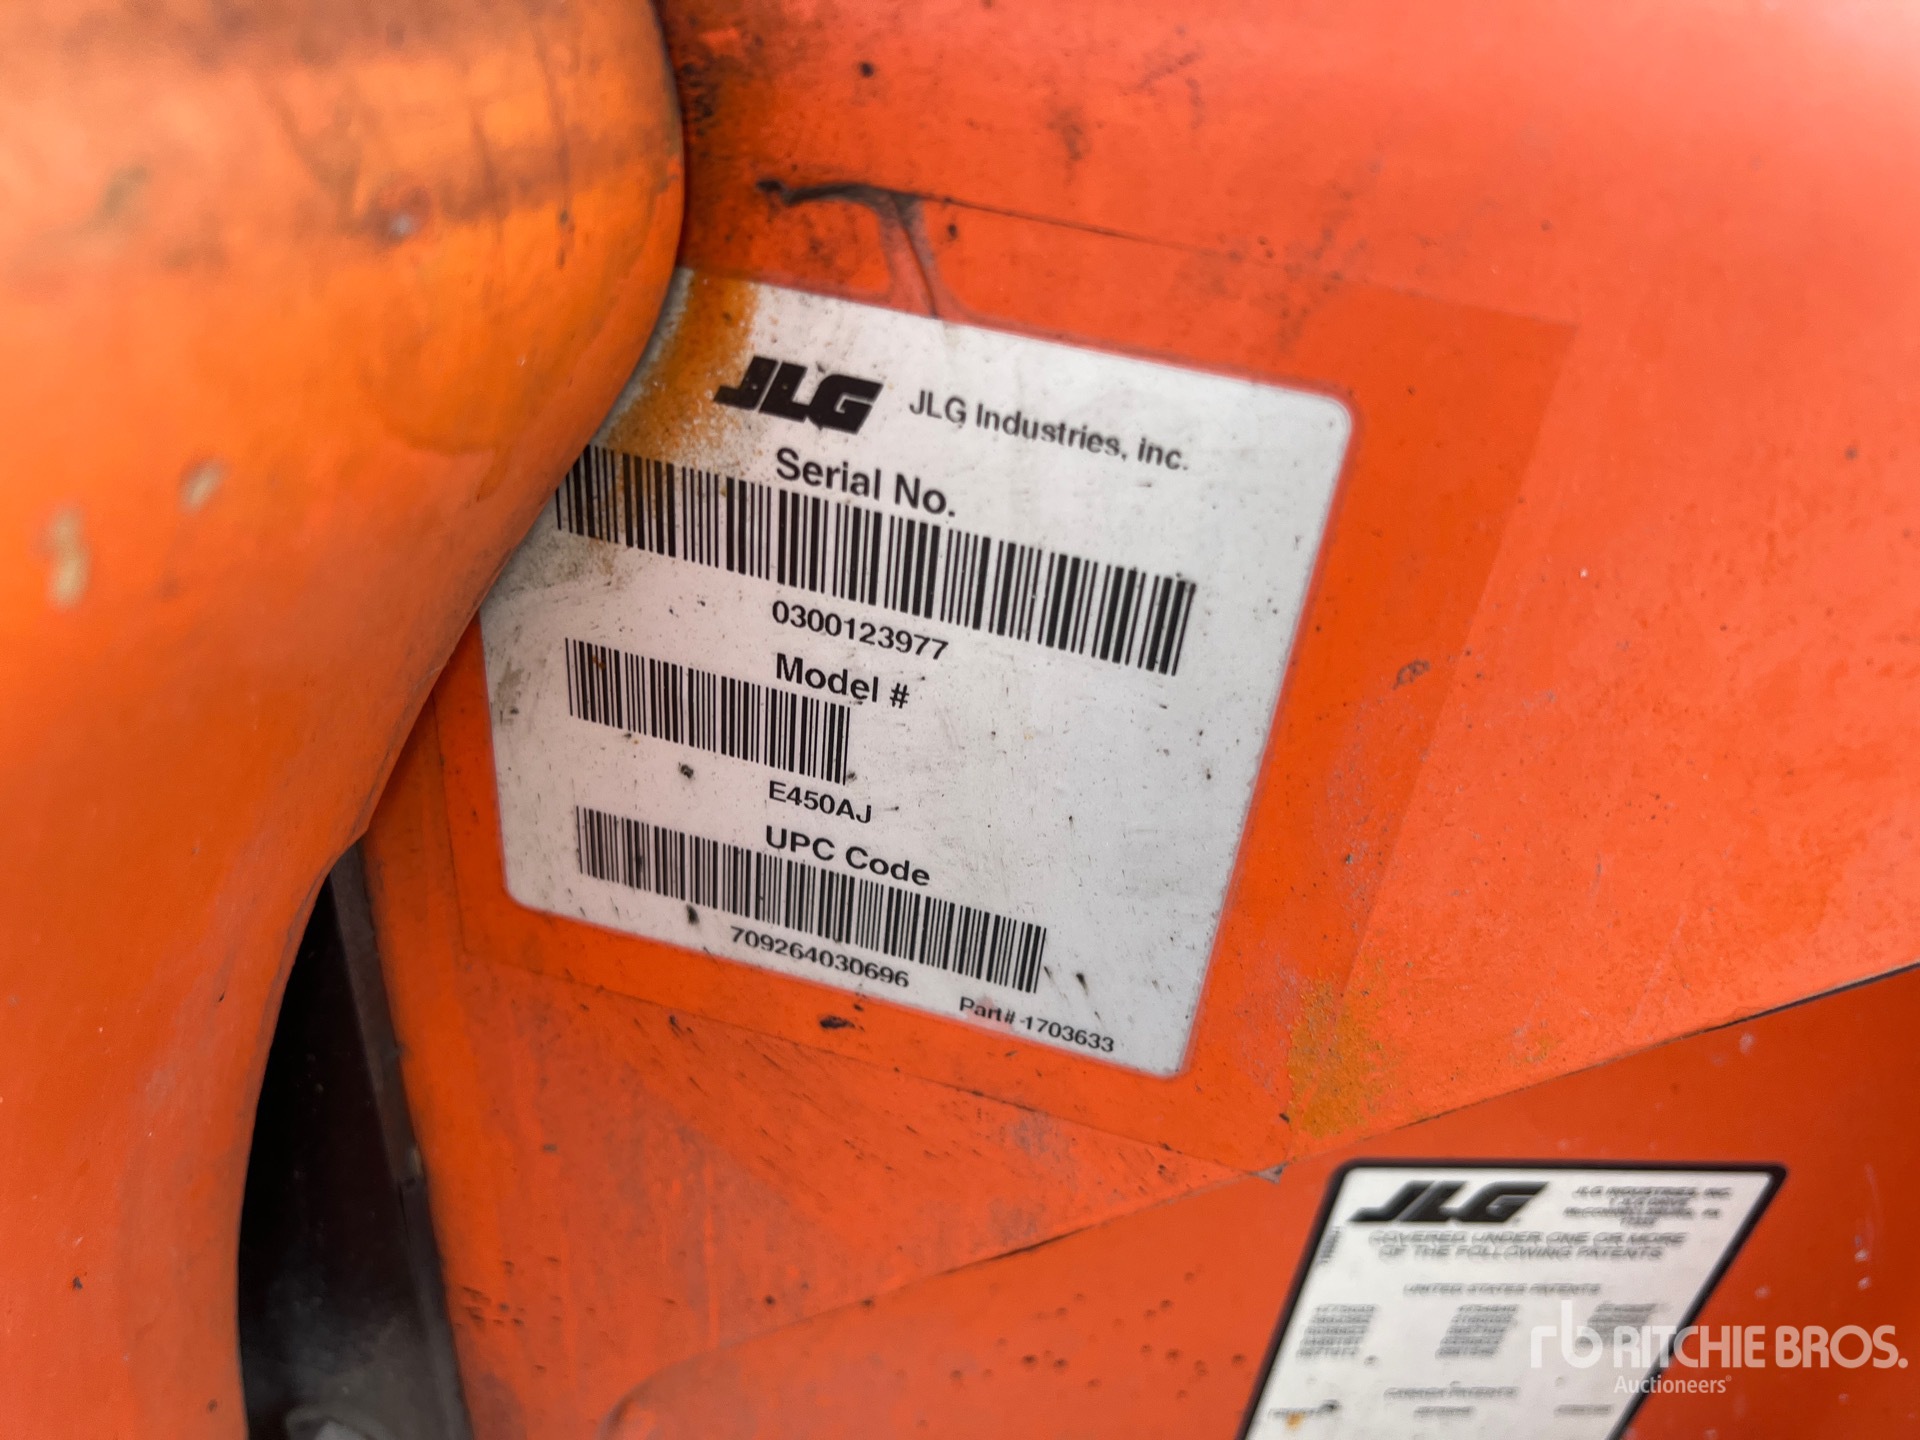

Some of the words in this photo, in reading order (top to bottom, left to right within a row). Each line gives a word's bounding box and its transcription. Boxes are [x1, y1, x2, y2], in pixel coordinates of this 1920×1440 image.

[713, 355, 883, 434] JLG
[910, 391, 967, 424] JLG
[976, 404, 1128, 461] Industries,
[1137, 437, 1189, 471] inc.
[776, 447, 881, 501] Serial
[894, 472, 956, 517] No.
[772, 600, 949, 660] 0300123977
[776, 653, 879, 703] Model
[889, 683, 910, 708] #
[769, 781, 872, 822] E450AJ
[766, 826, 834, 862] UPC
[845, 845, 930, 887] Code
[730, 926, 910, 988] 709264030696
[959, 996, 1016, 1025] Part#
[1349, 1181, 1549, 1223] JLG
